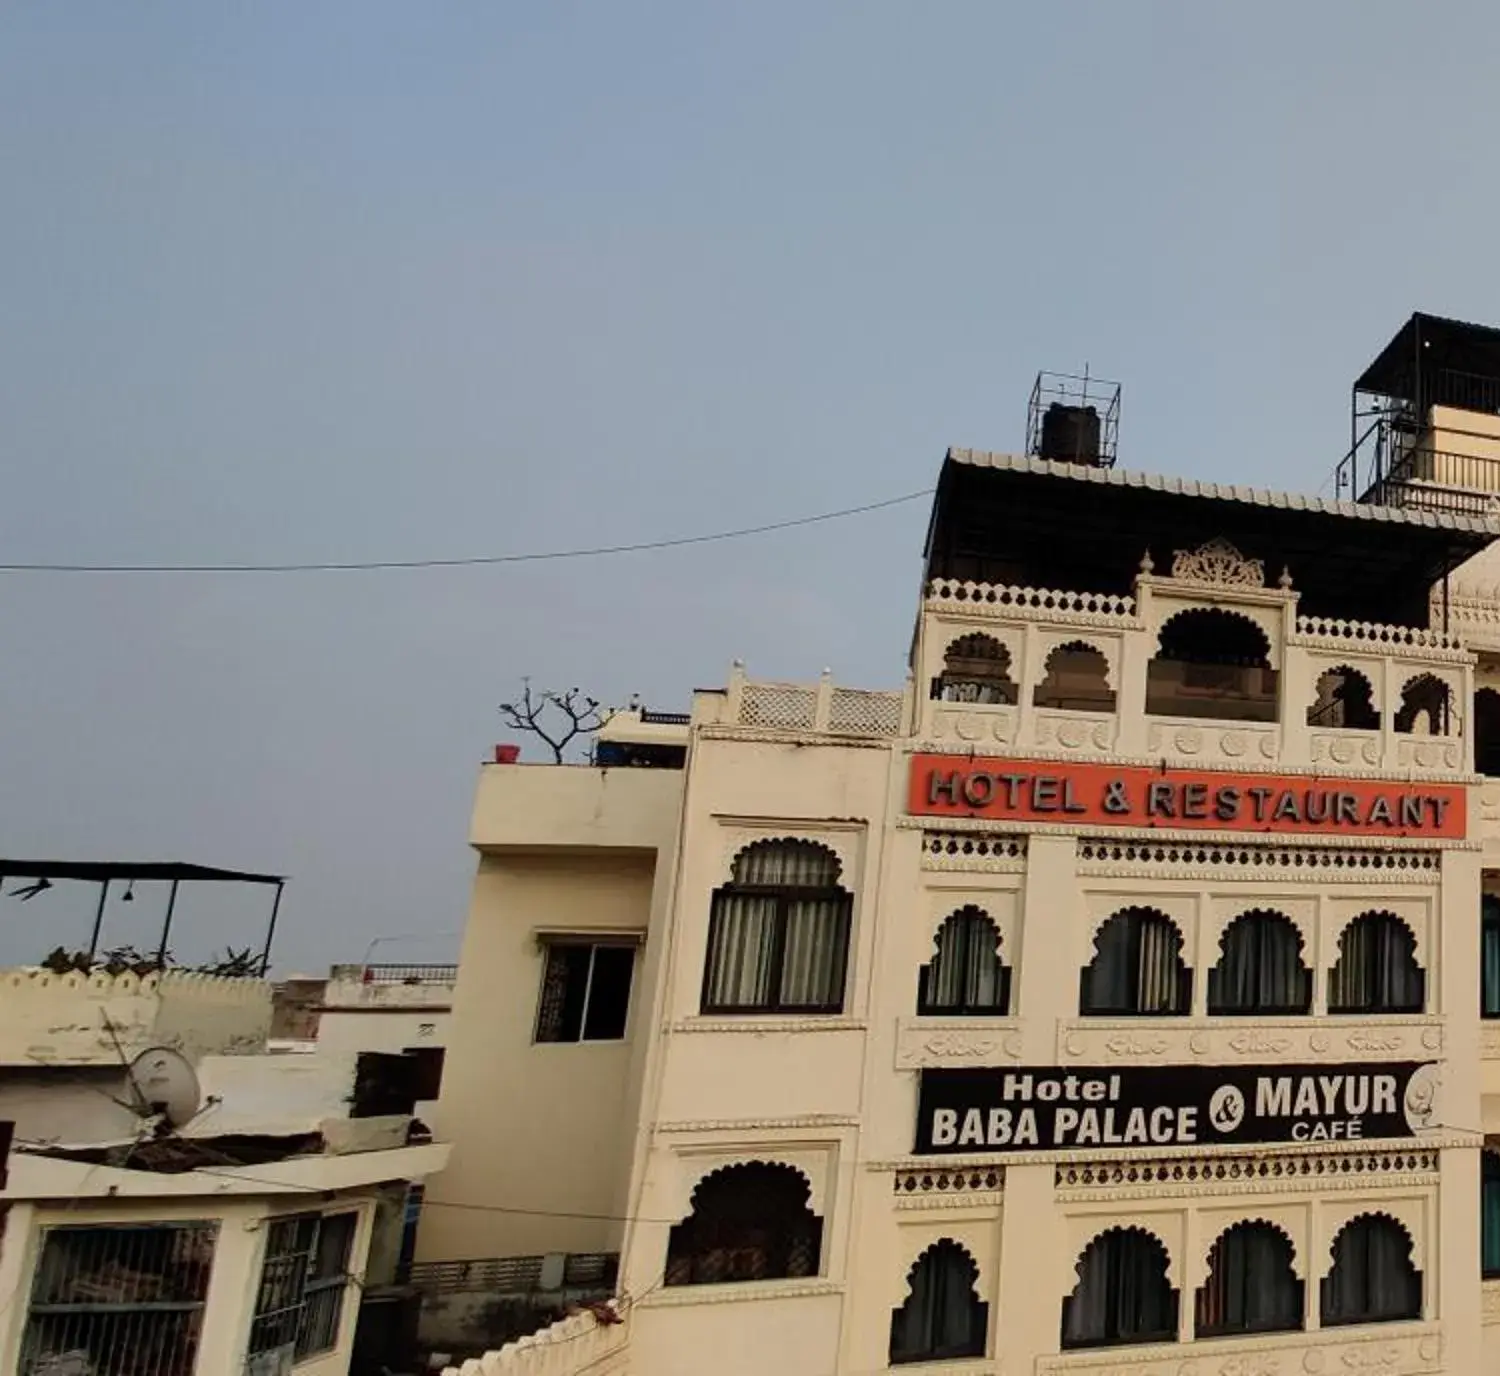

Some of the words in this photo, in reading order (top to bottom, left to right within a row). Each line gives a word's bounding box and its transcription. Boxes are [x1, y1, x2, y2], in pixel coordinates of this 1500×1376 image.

[927, 770, 1086, 812] HOTEL
[1103, 779, 1130, 814] &
[1147, 782, 1450, 827] RESTAURANT
[1003, 1074, 1121, 1101] Hotel
[932, 1108, 1039, 1145] BABA
[1053, 1106, 1198, 1143] PALACE
[1215, 1093, 1238, 1124] &
[1255, 1075, 1397, 1117] MAYUR
[1291, 1116, 1363, 1141] CAFÉ
